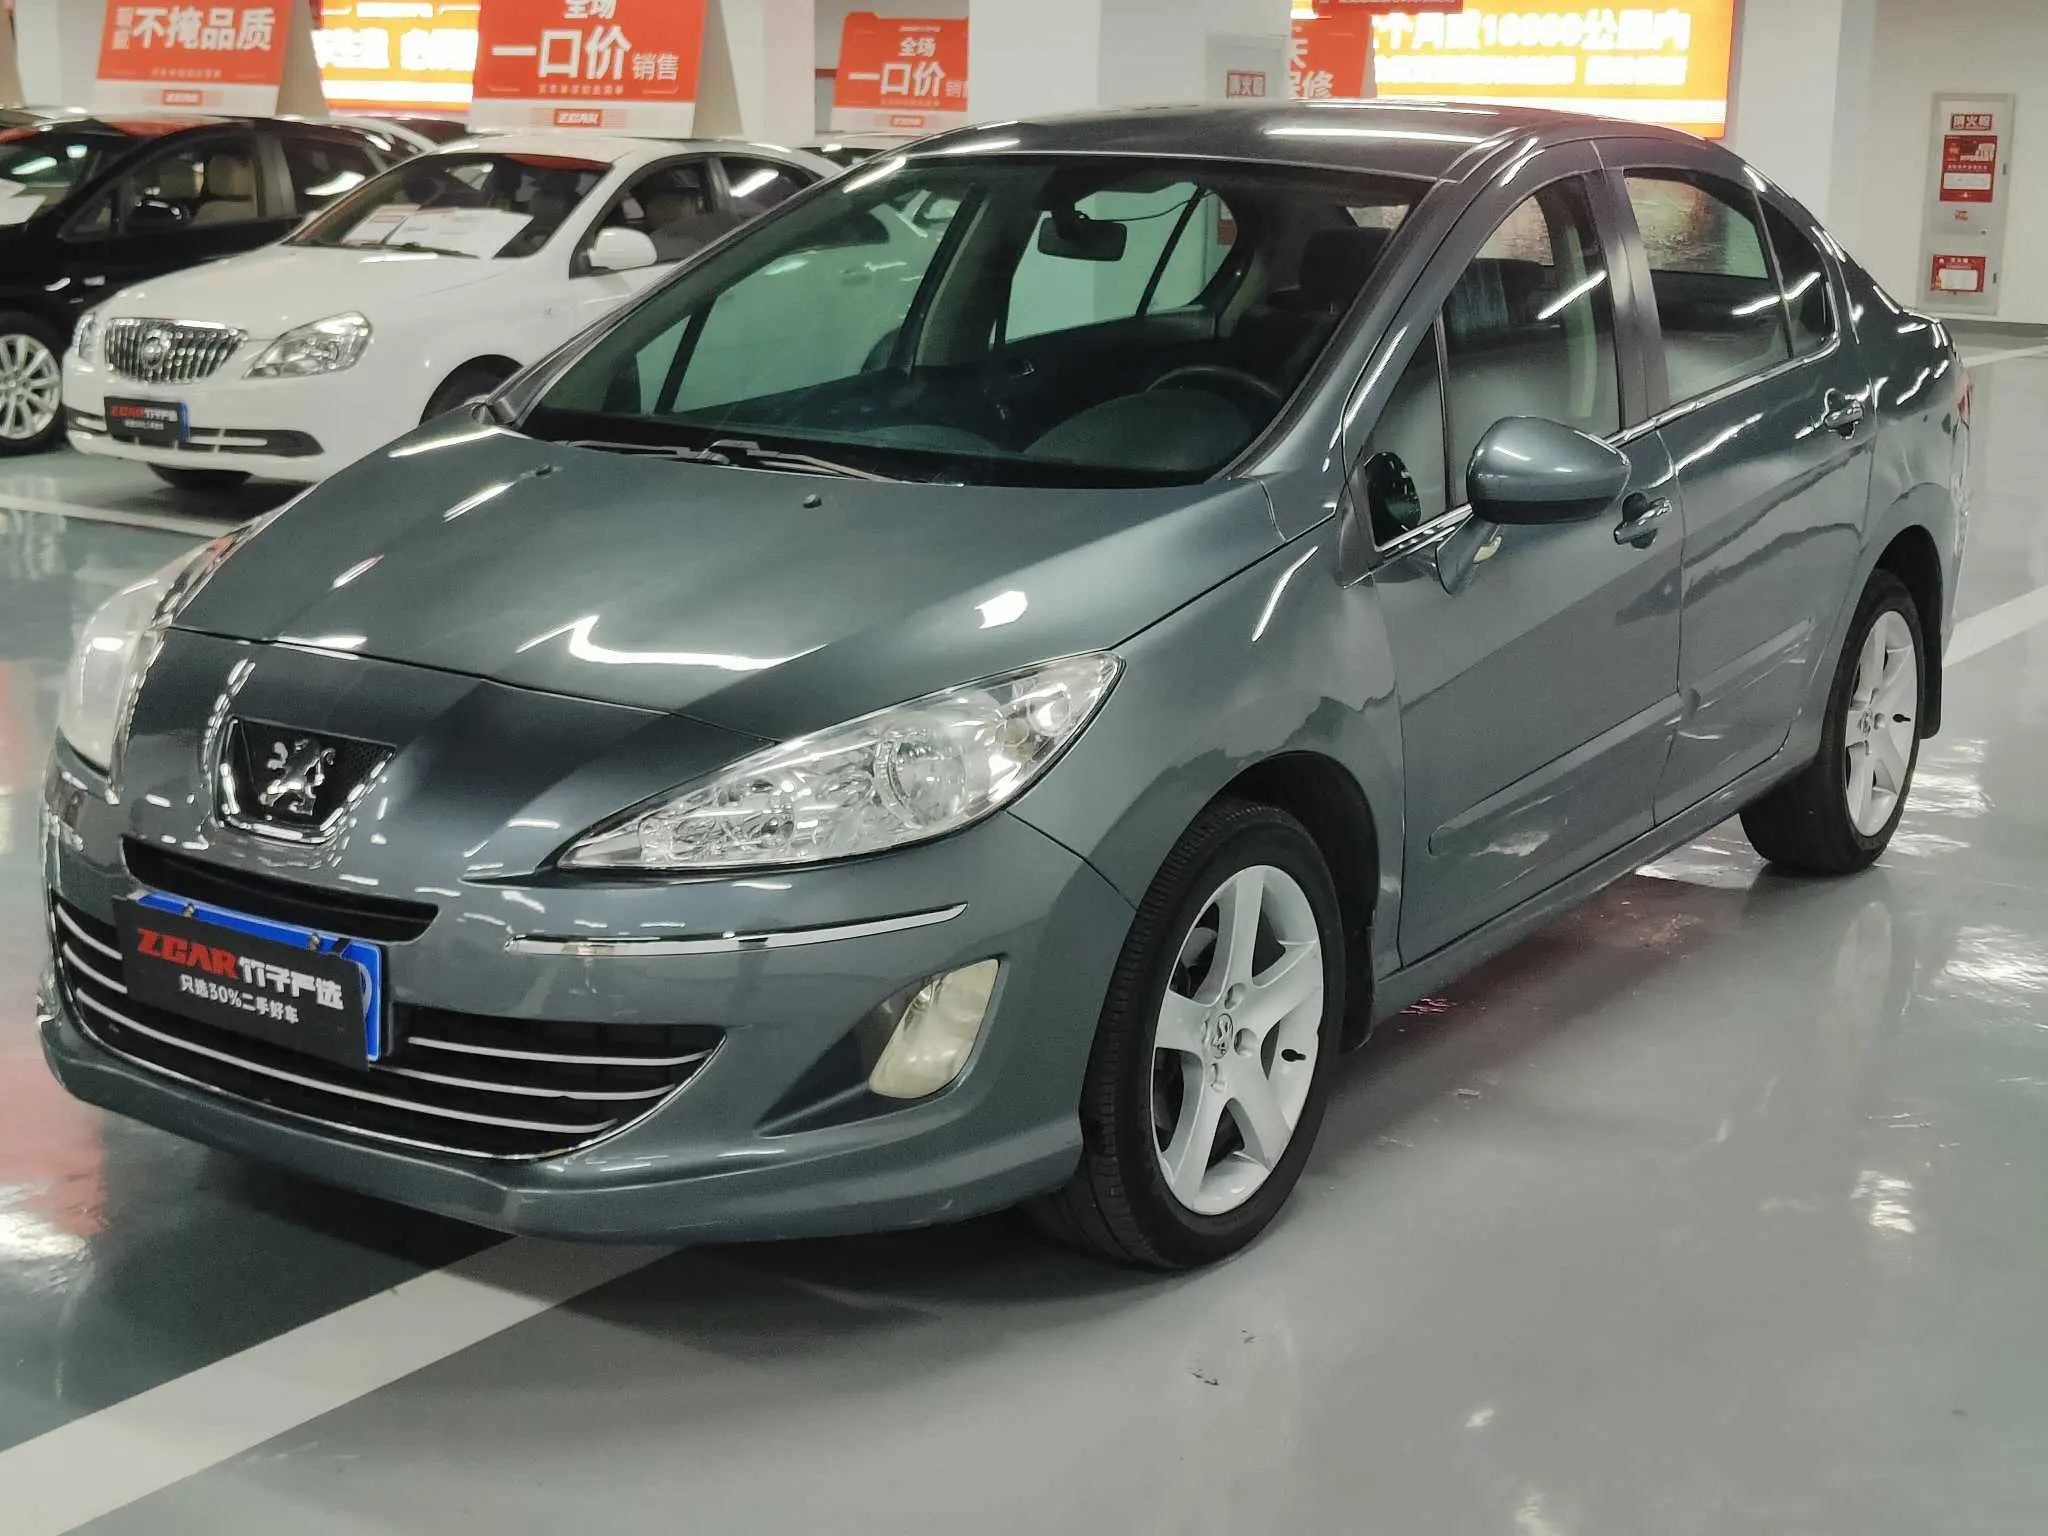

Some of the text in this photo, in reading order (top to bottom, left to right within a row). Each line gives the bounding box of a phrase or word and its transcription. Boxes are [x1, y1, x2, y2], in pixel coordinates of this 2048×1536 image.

[133, 6, 275, 52] 不掩品质
[898, 37, 937, 57] 全场
[491, 24, 632, 80] 一口价
[632, 53, 680, 81] 销售
[847, 60, 947, 97] 一口价
